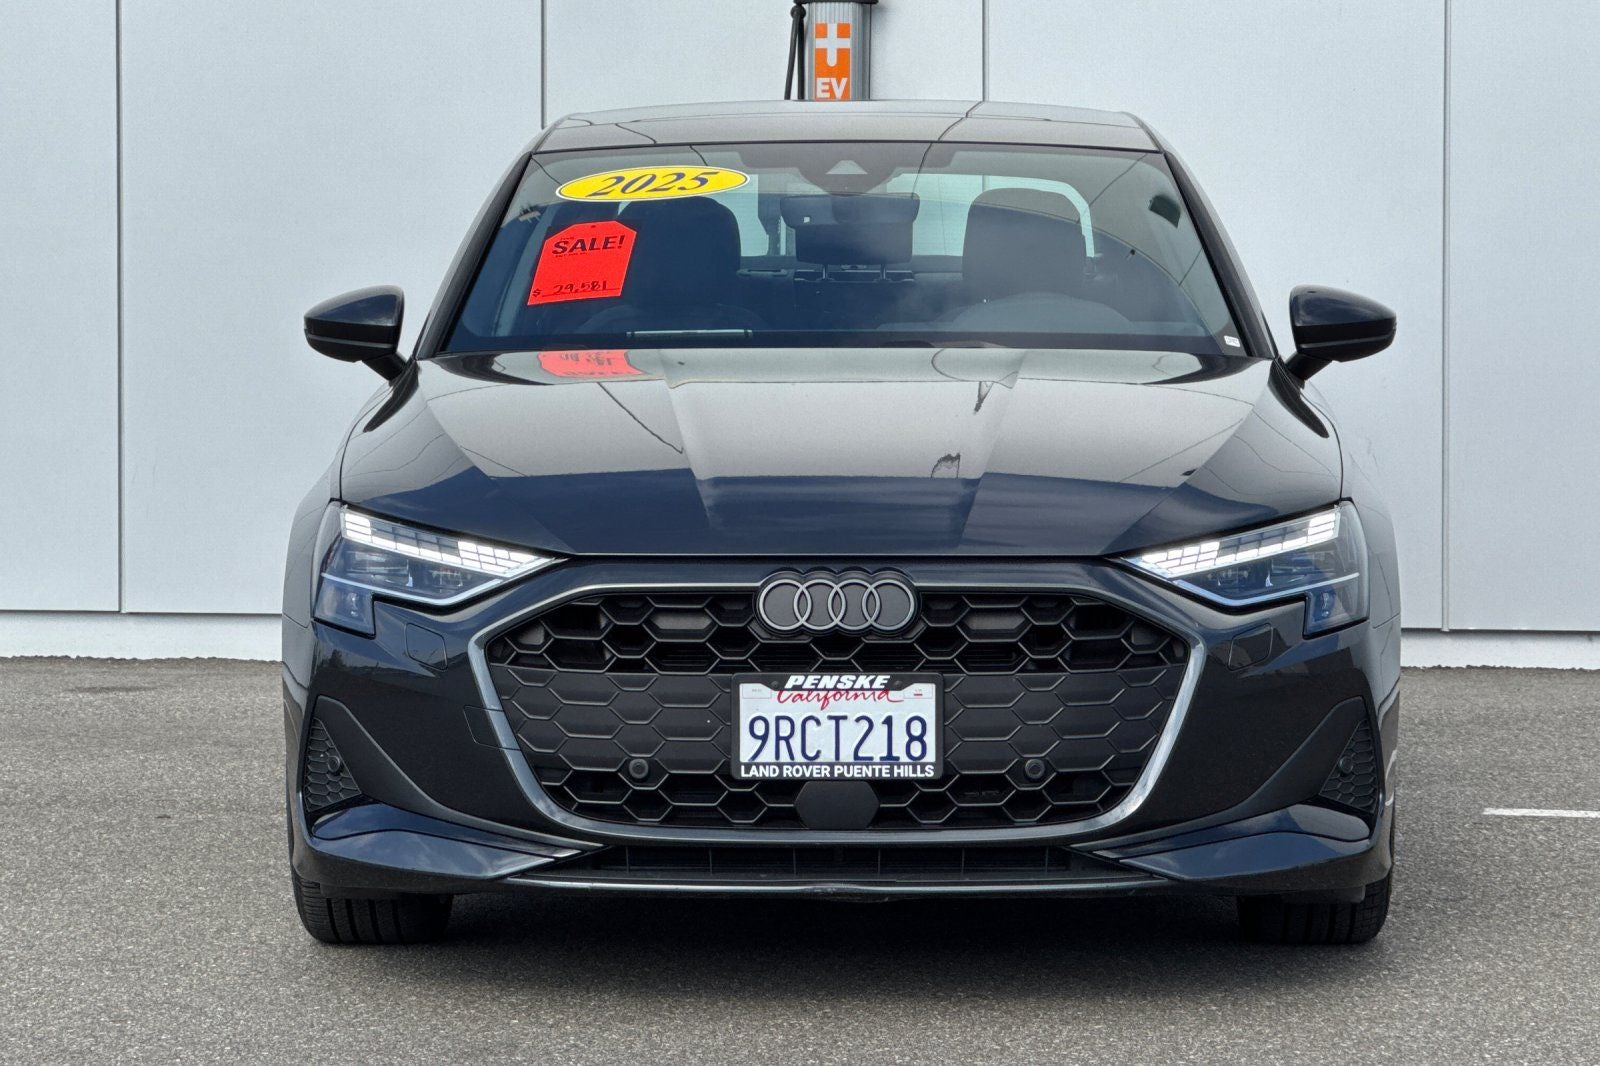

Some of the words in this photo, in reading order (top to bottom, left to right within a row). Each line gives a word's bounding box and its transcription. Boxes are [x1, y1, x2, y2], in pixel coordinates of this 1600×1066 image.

[816, 77, 848, 99] EV
[585, 171, 720, 198] 2025
[552, 235, 625, 255] SALE!
[784, 675, 890, 689] PENSKE
[776, 688, 904, 711] California
[748, 715, 928, 762] 9RCT218
[741, 765, 779, 778] LAND
[782, 765, 830, 778] ROVER
[834, 765, 891, 778] PUENTE
[893, 765, 935, 778] HILLS
